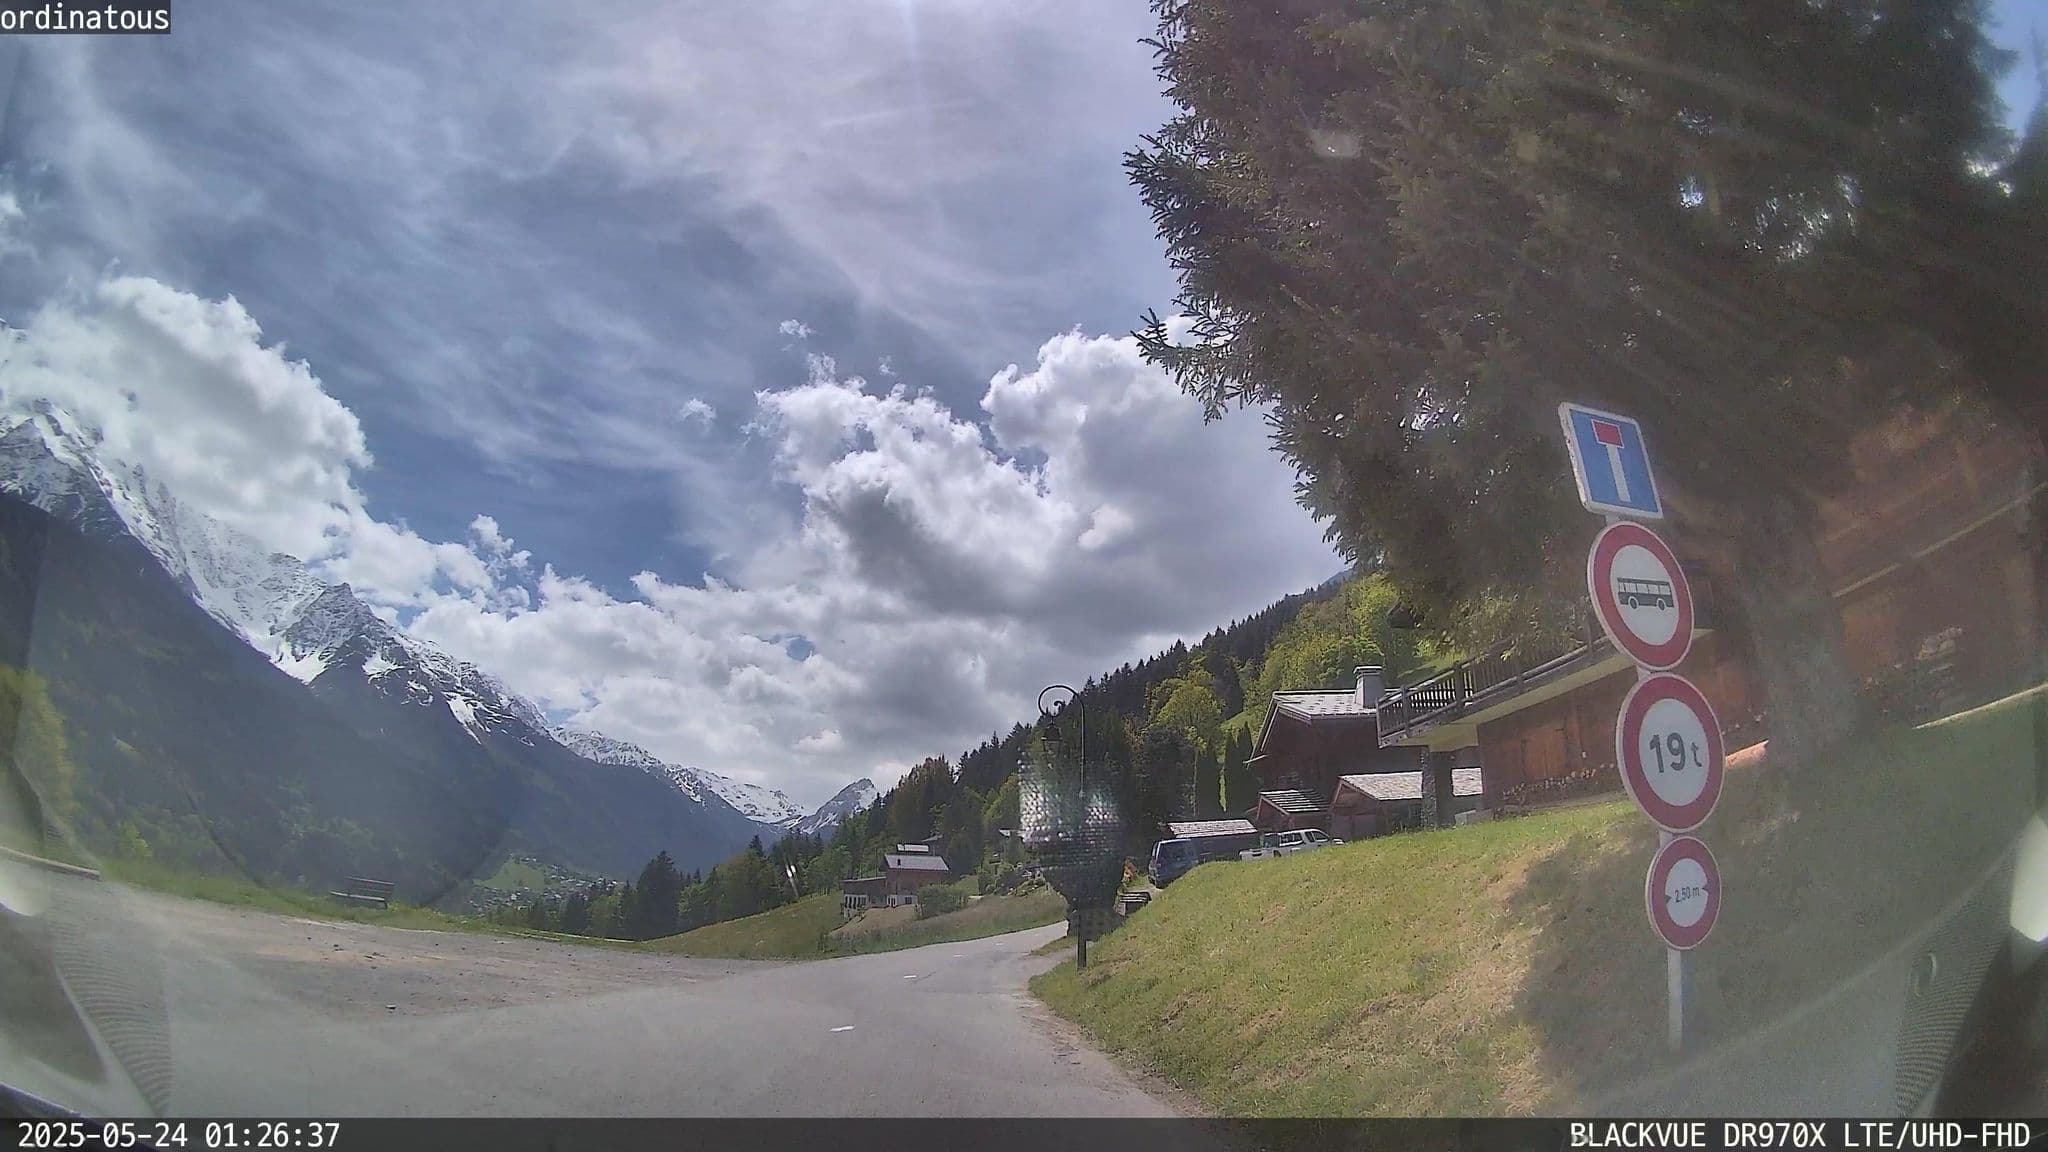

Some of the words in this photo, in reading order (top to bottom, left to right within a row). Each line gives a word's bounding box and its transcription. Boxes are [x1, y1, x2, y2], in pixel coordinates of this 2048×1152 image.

[1649, 732, 1686, 774] 19
[1691, 741, 1702, 768] t
[1692, 887, 1700, 898] m
